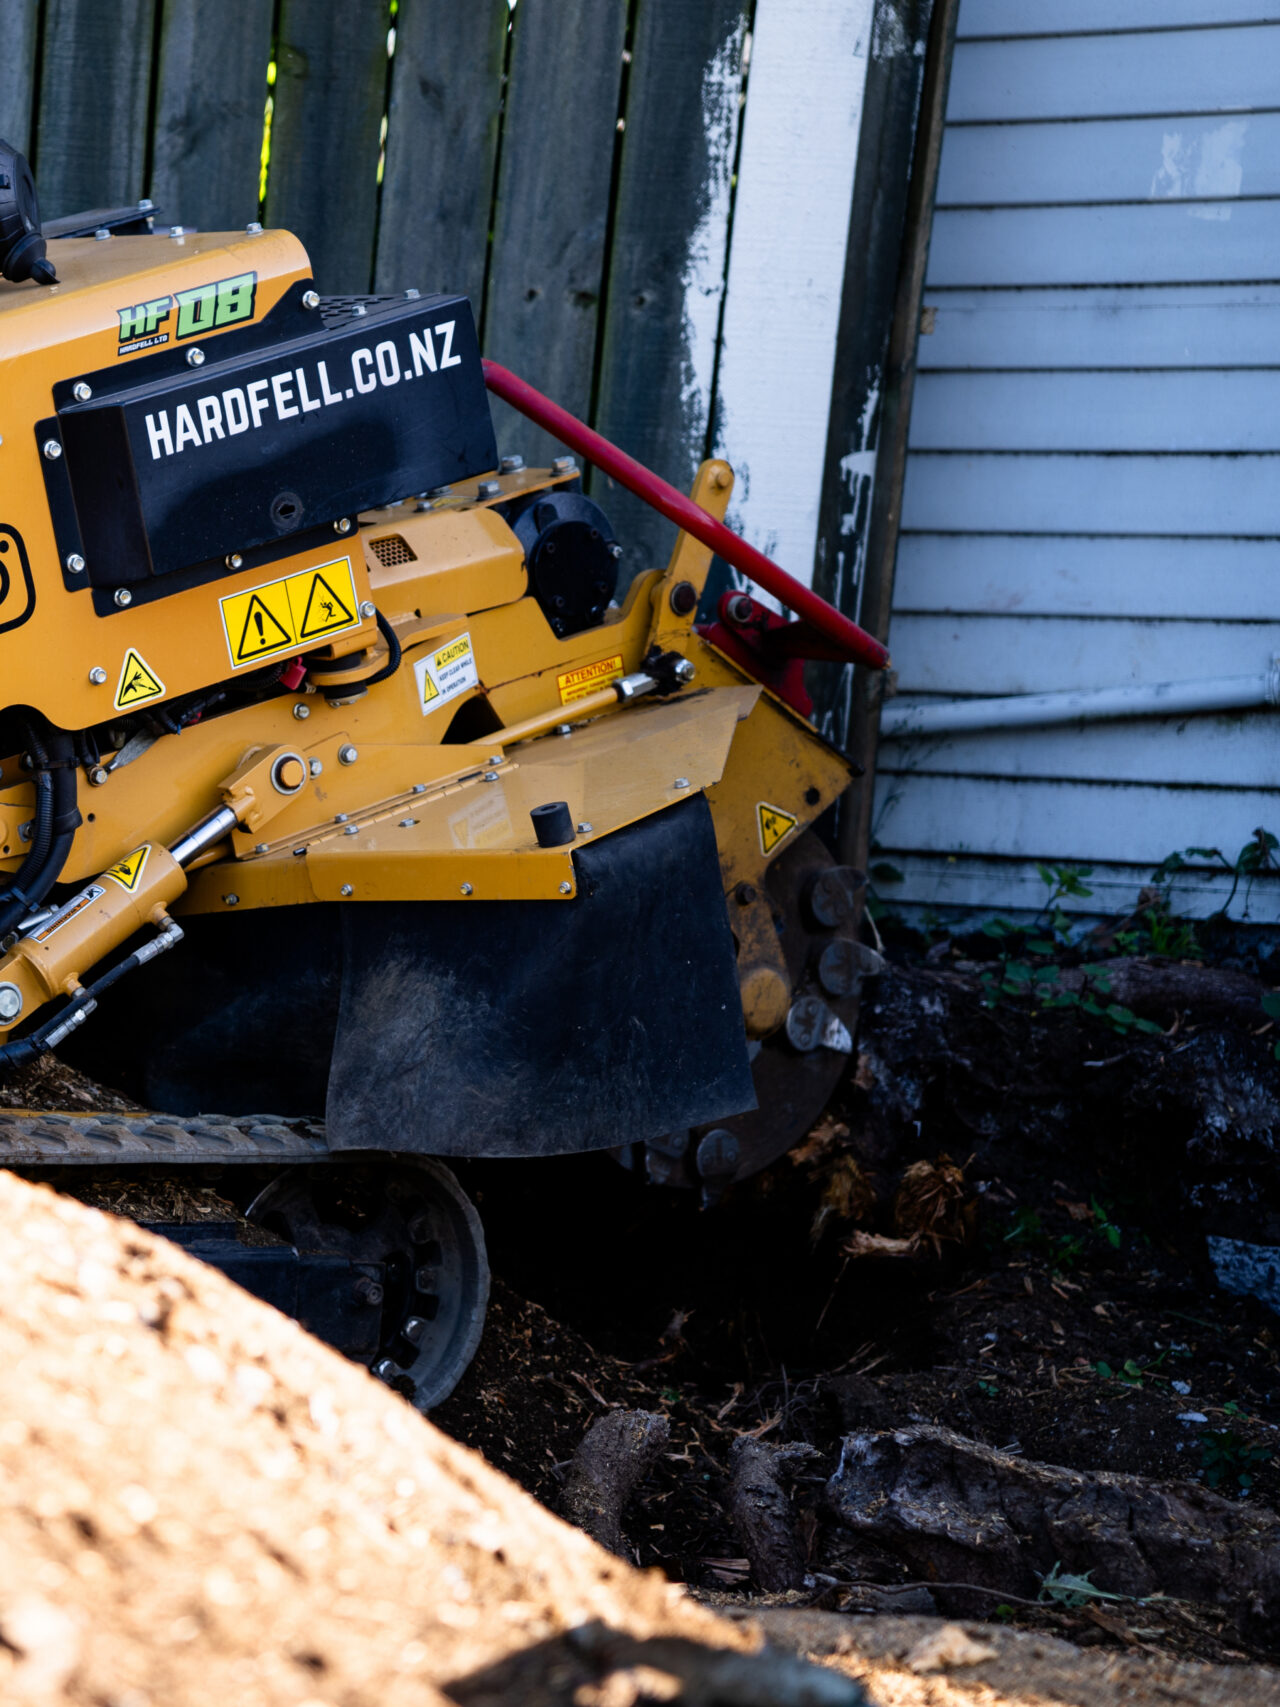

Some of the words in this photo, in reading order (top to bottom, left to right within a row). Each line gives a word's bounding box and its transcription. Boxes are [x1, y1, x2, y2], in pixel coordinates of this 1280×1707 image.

[117, 295, 173, 342] HF
[144, 320, 462, 460] HARDFELL.CO.NZ
[441, 640, 469, 662] CAUTION
[565, 660, 616, 685] ATTENTION!
